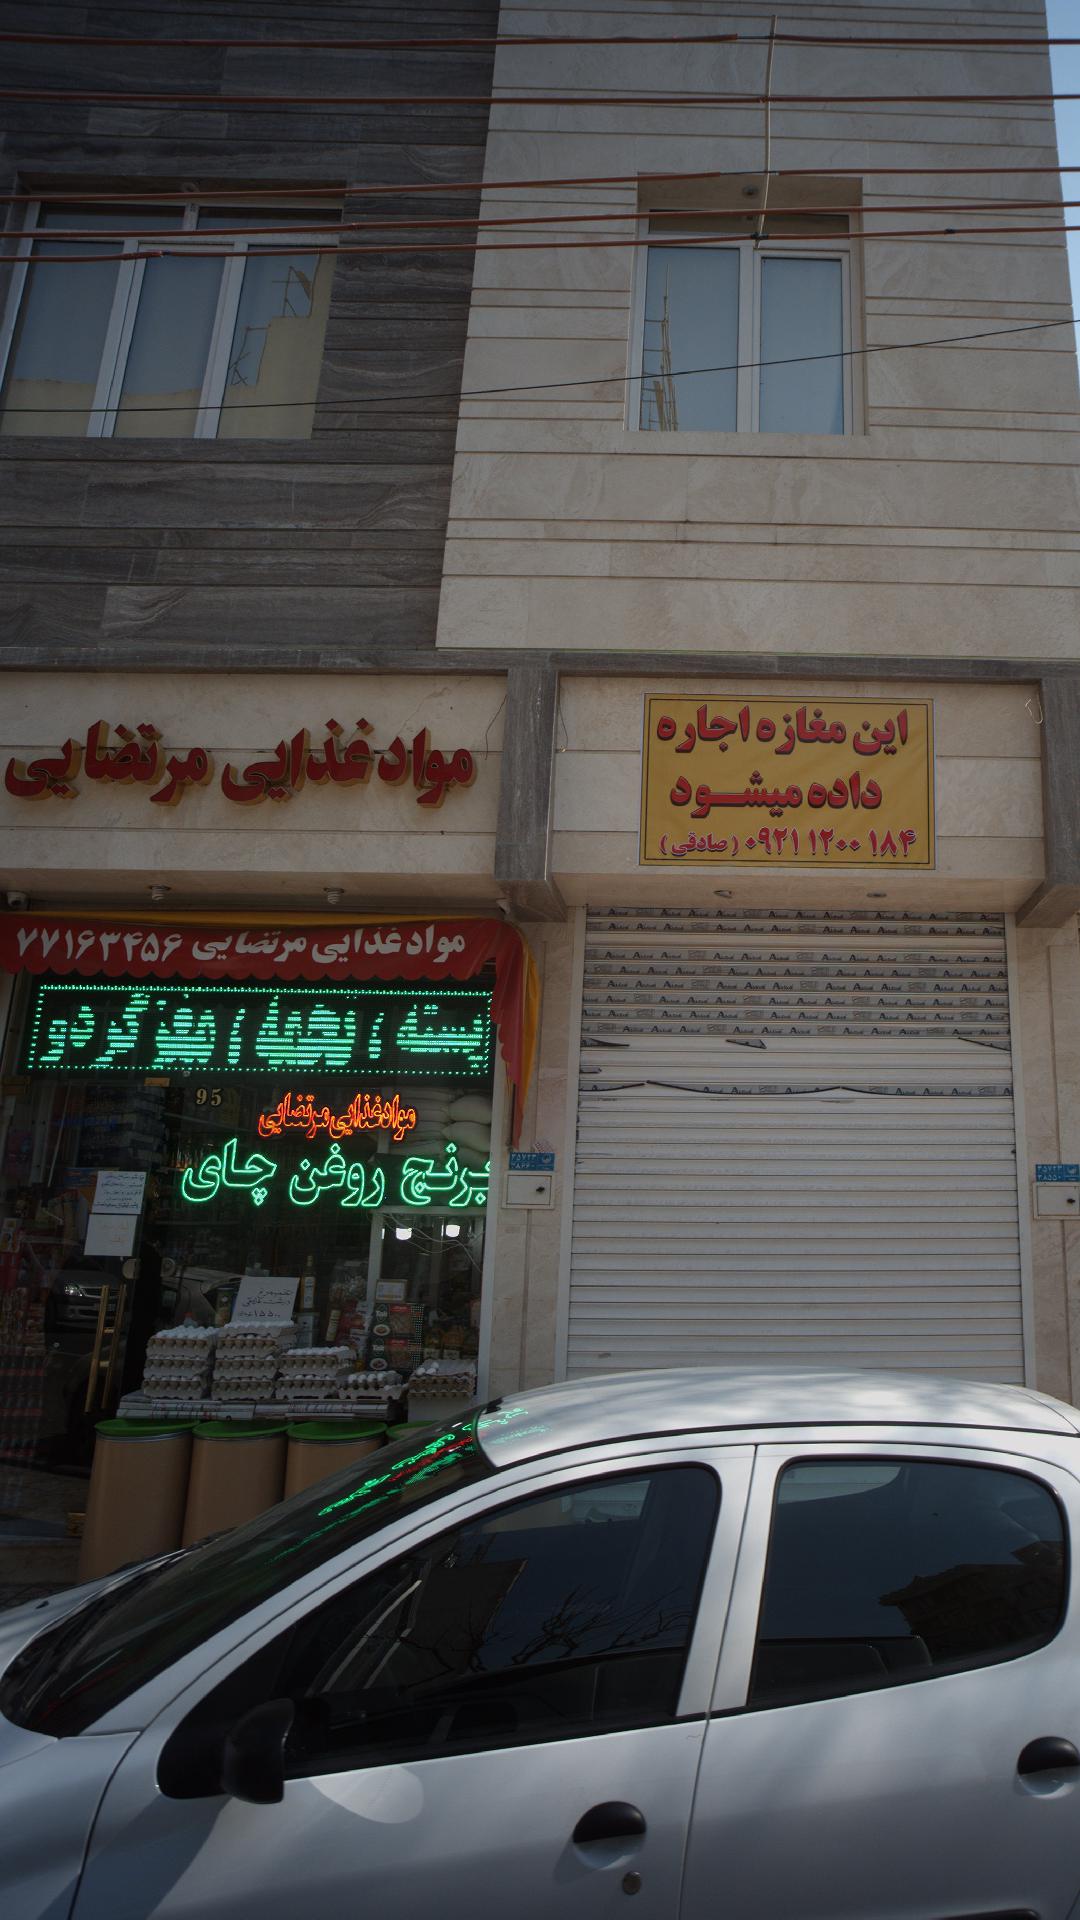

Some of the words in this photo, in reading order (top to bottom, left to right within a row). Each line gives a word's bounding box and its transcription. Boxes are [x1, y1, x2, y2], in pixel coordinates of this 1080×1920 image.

[656, 704, 750, 753] اجاره
[756, 706, 847, 755] مغازه
[853, 708, 908, 756] این
[4, 719, 213, 806] مرتضایی
[220, 718, 375, 804] غذایی
[377, 725, 477, 808] مواد
[670, 770, 803, 819] میشود
[807, 770, 883, 810] داده
[745, 826, 799, 856] ۰۹۲۱
[808, 828, 861, 857] ۱۲۰۰
[869, 828, 917, 857] ۱۸۴
[16, 928, 184, 962] ۷۷۱۶۳۴۵۶
[191, 930, 307, 963] مرتضایی
[311, 926, 402, 964] غذایی
[405, 924, 466, 963] مواد
[195, 1087, 222, 1107] 95
[181, 1137, 278, 1207] چای
[289, 1142, 386, 1207] روغن
[399, 1142, 491, 1207] برنج
